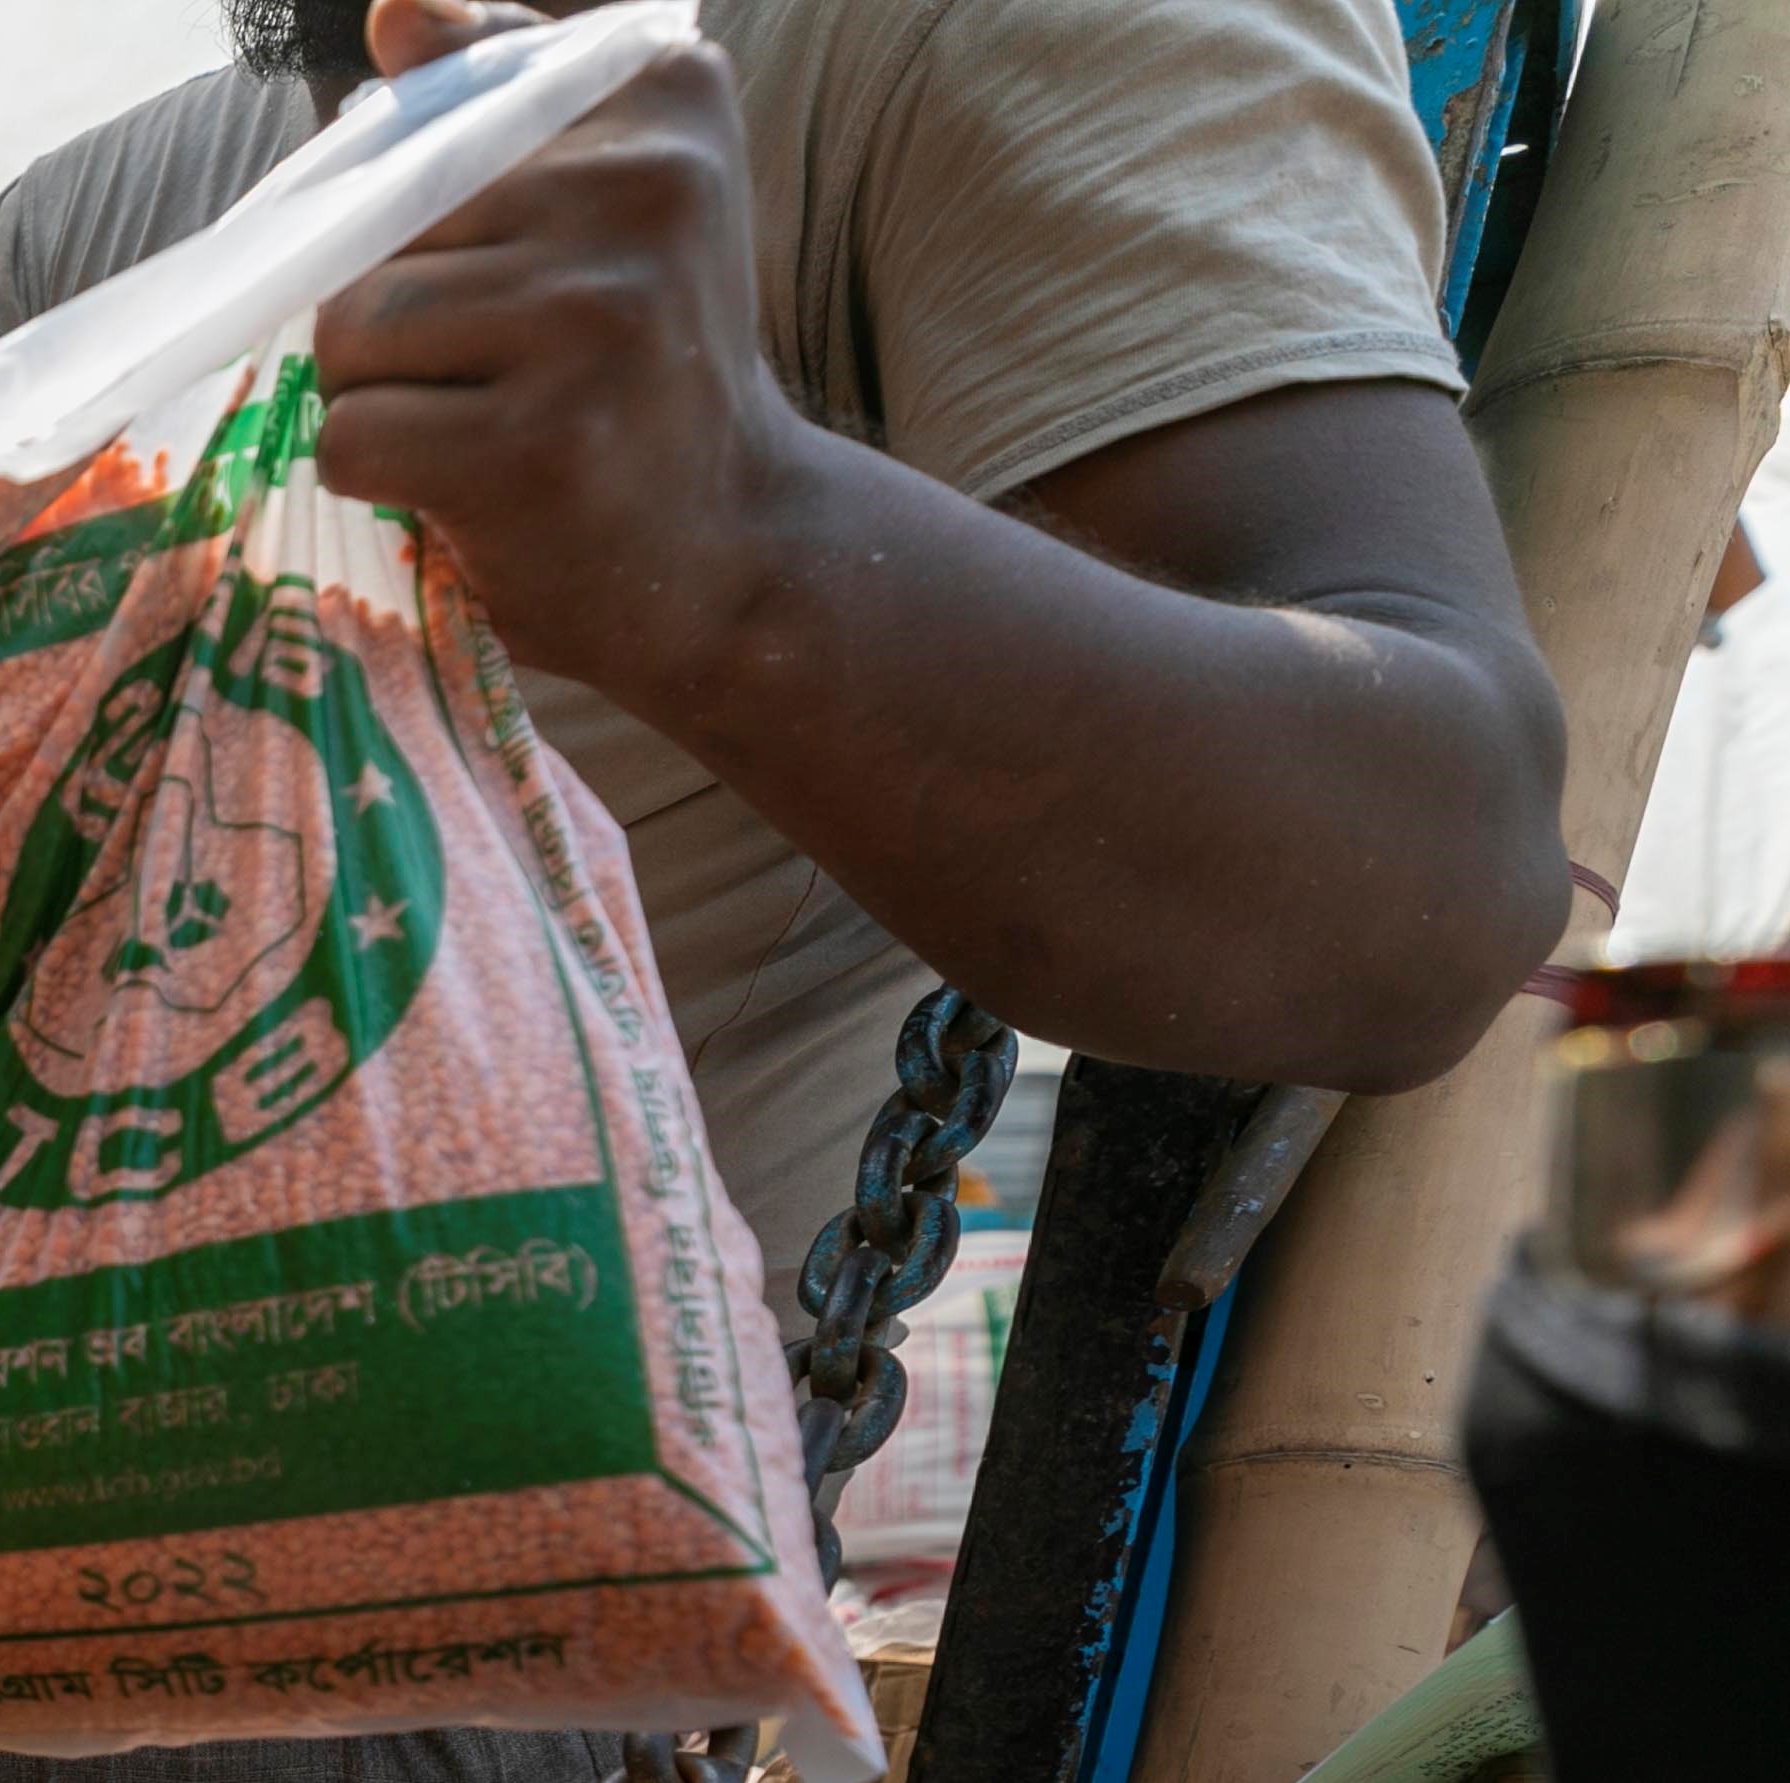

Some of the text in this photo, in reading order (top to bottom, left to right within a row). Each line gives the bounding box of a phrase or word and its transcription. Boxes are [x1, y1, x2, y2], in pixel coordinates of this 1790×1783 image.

[167, 1279, 377, 1352] বাংলাদেশ
[396, 1237, 598, 1332] (টিসিবি)
[76, 1549, 268, 1611] ২০২২
[108, 1650, 226, 1700] সিটি
[248, 1630, 568, 1695] কর্পোরেশন
